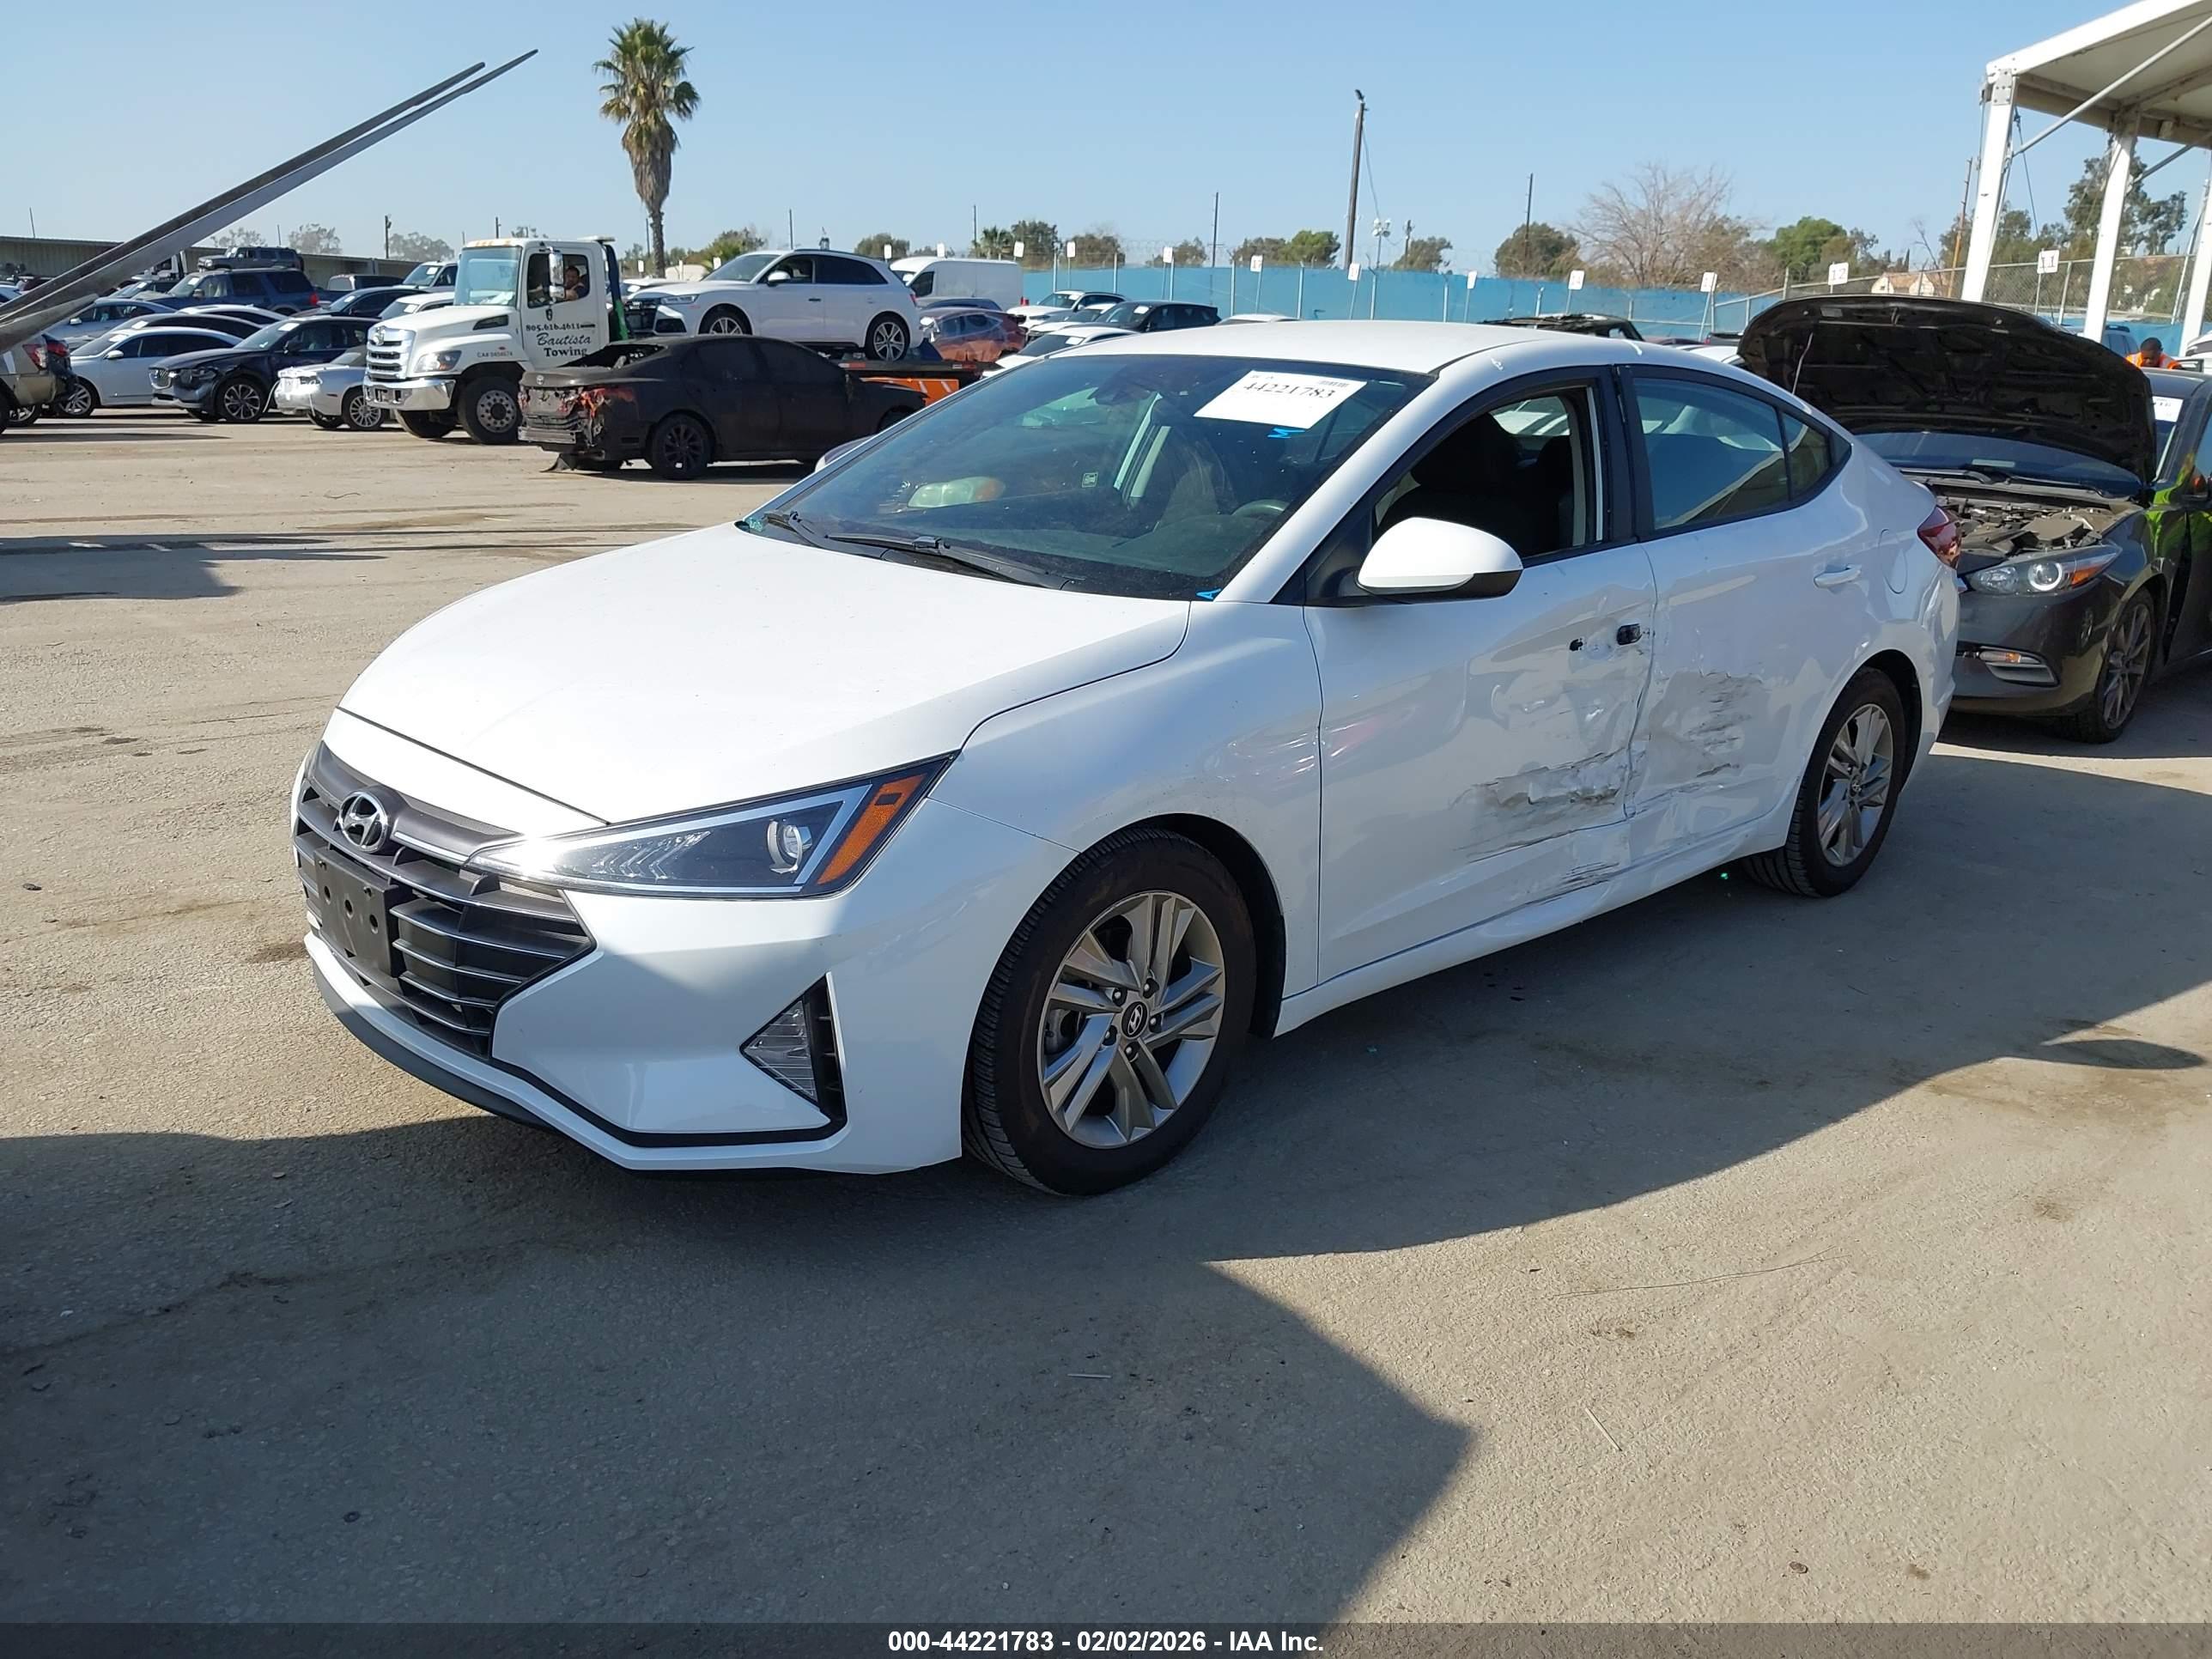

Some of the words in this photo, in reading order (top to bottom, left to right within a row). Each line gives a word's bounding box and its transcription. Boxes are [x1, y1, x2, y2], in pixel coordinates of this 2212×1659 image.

[2039, 255, 2056, 269] 11
[1831, 268, 1847, 281] 12
[536, 332, 592, 346] Bautista
[544, 347, 587, 358] Towing
[1243, 382, 1336, 398] 44221783
